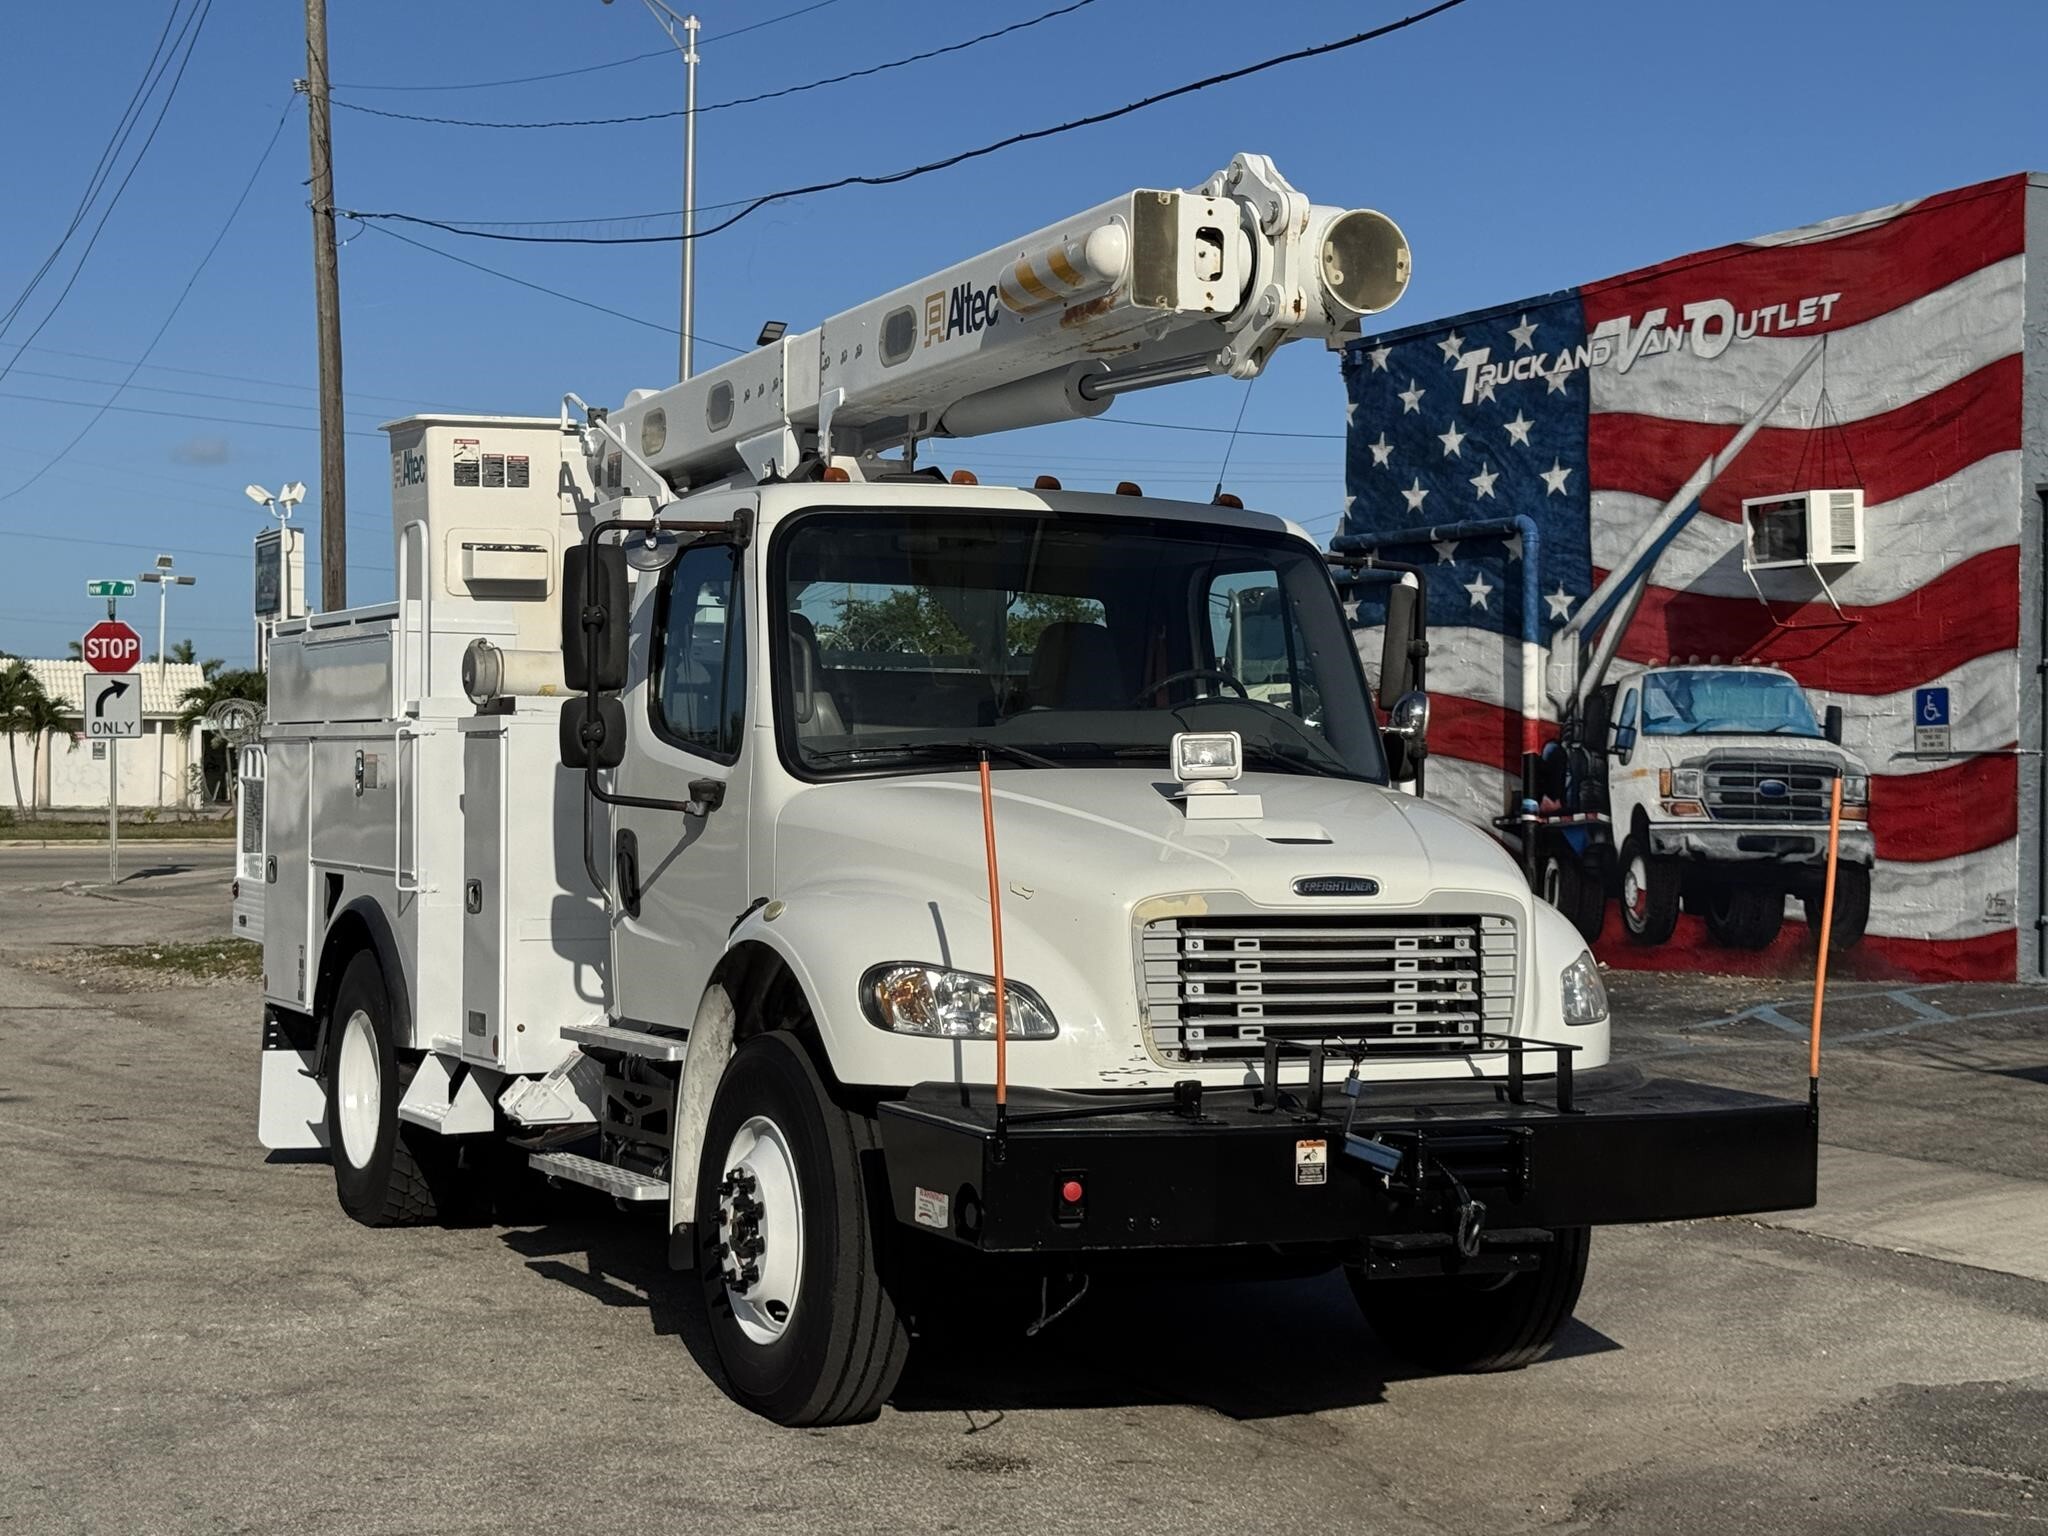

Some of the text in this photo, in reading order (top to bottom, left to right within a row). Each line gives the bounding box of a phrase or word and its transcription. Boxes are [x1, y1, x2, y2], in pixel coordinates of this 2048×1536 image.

[945, 281, 999, 341] Altec
[403, 449, 425, 487] Altec
[90, 584, 102, 595] NW
[108, 582, 117, 595] 7
[87, 638, 138, 659] STOP
[92, 721, 135, 735] ONLY
[1304, 881, 1373, 892] FREIGHTLINER
